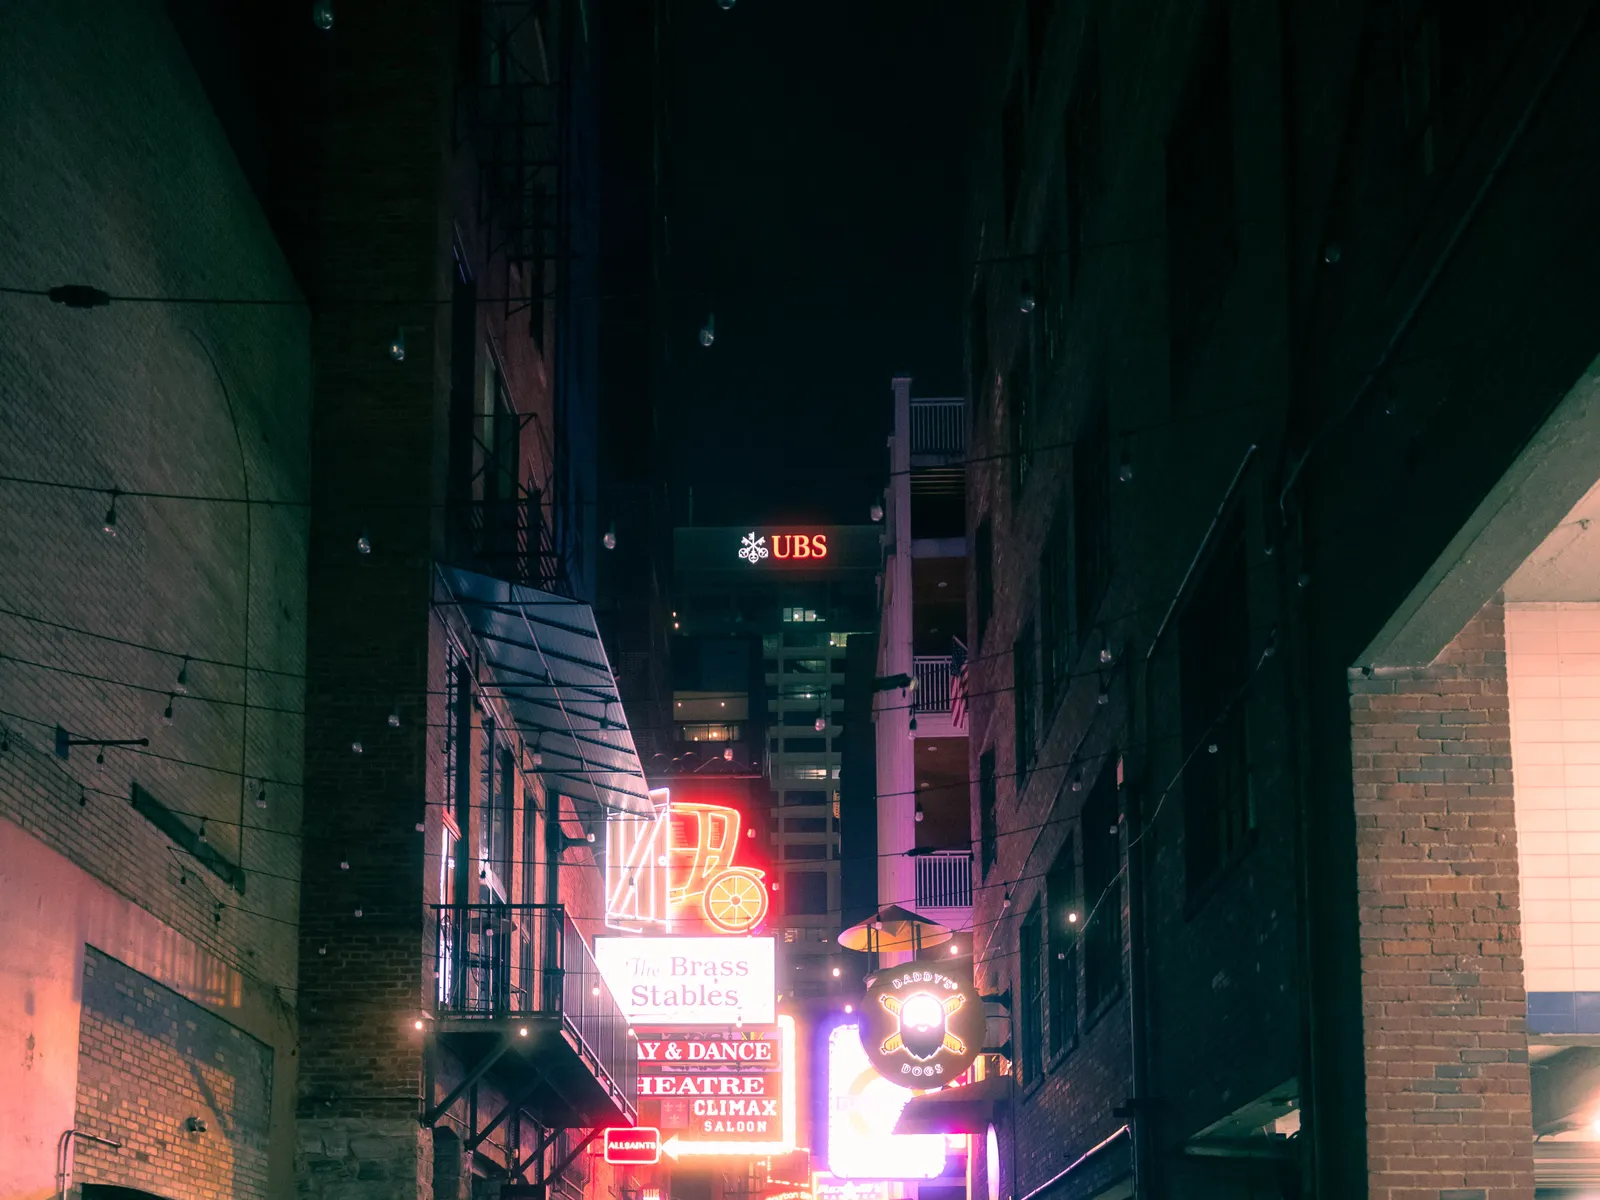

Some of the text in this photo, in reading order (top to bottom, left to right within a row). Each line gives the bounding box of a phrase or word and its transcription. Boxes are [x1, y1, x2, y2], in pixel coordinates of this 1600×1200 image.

[771, 534, 828, 558] UBS
[631, 956, 749, 977] The Brass
[631, 984, 739, 1007] Stables
[664, 1042, 682, 1060] &
[687, 1042, 772, 1060] DANCE
[901, 1063, 943, 1077] DOGS
[637, 1076, 765, 1095] HEATRE
[694, 1099, 777, 1116] CLIMAX
[703, 1120, 768, 1133] SALOON
[608, 1141, 656, 1150] ALLSAINTS
